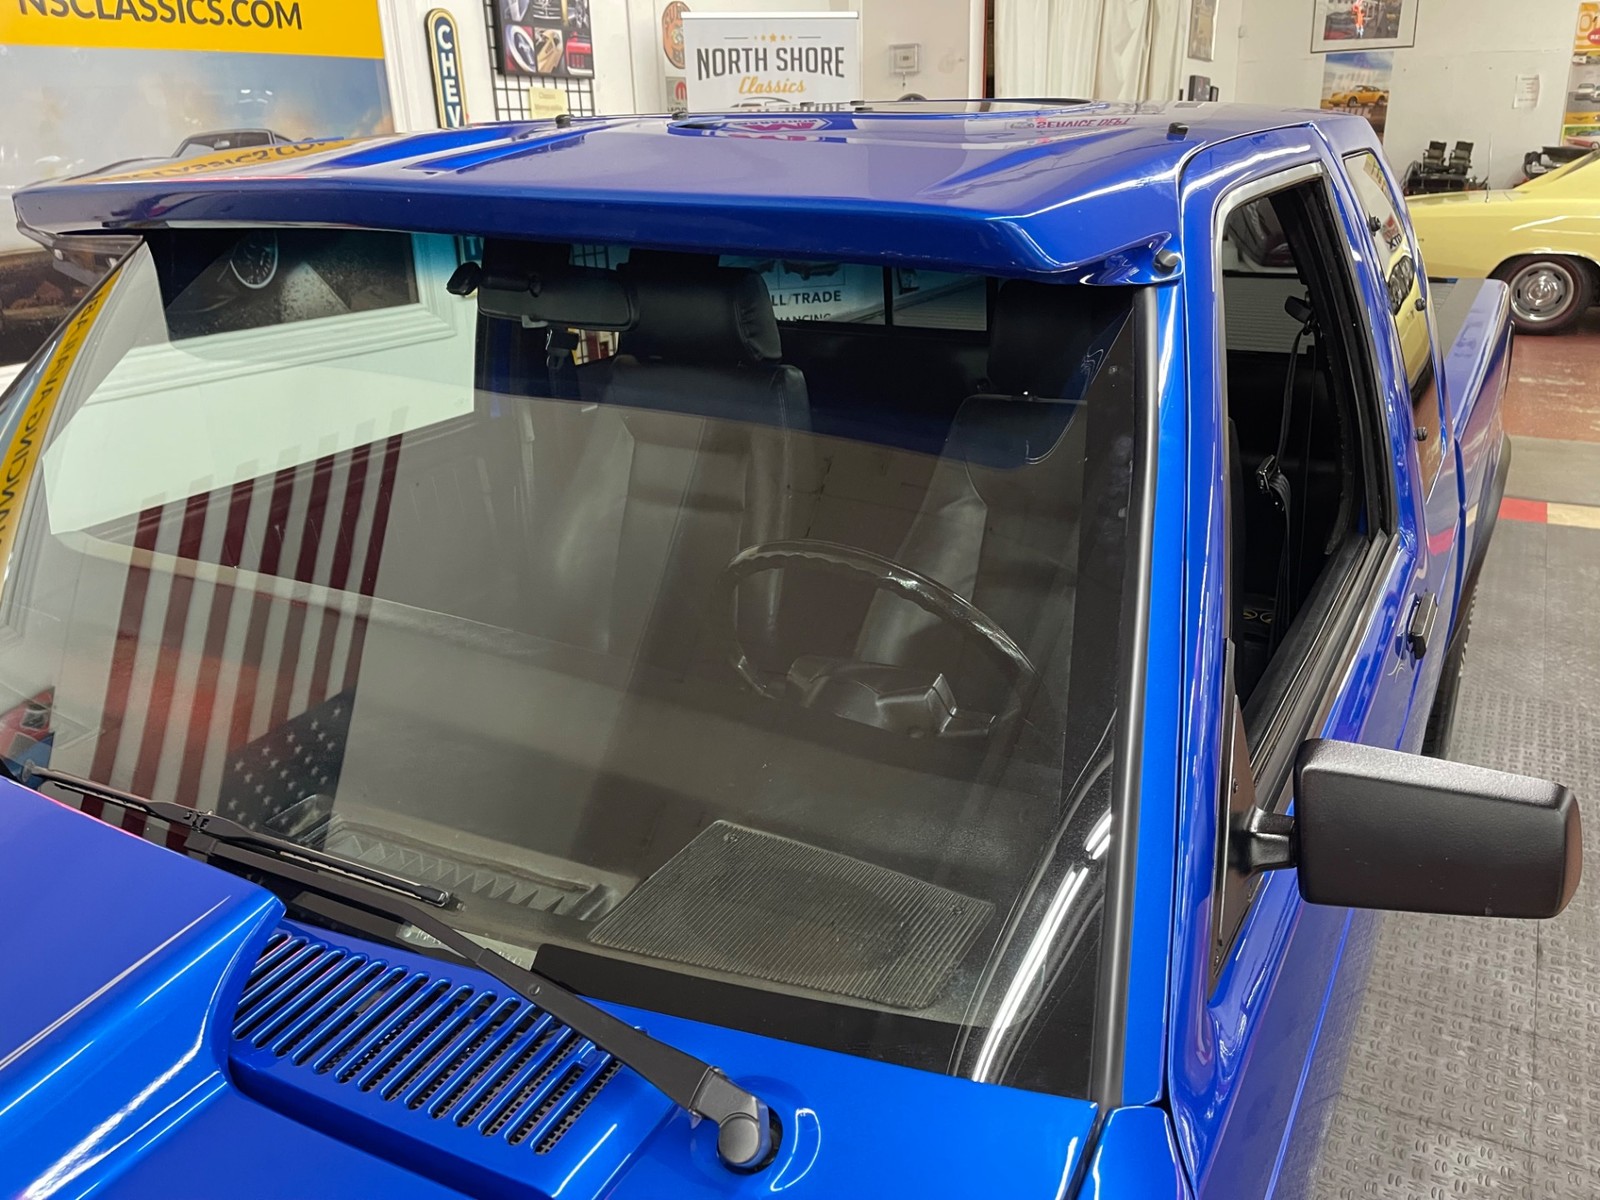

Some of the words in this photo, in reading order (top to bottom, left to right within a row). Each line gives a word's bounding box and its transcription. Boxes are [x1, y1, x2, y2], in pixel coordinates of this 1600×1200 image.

[19, 0, 303, 30] NSCLASSICS.COM
[696, 47, 768, 81] NORTH
[776, 46, 845, 78] SHORE
[738, 75, 807, 95] Classics
[793, 289, 842, 304] TRADE
